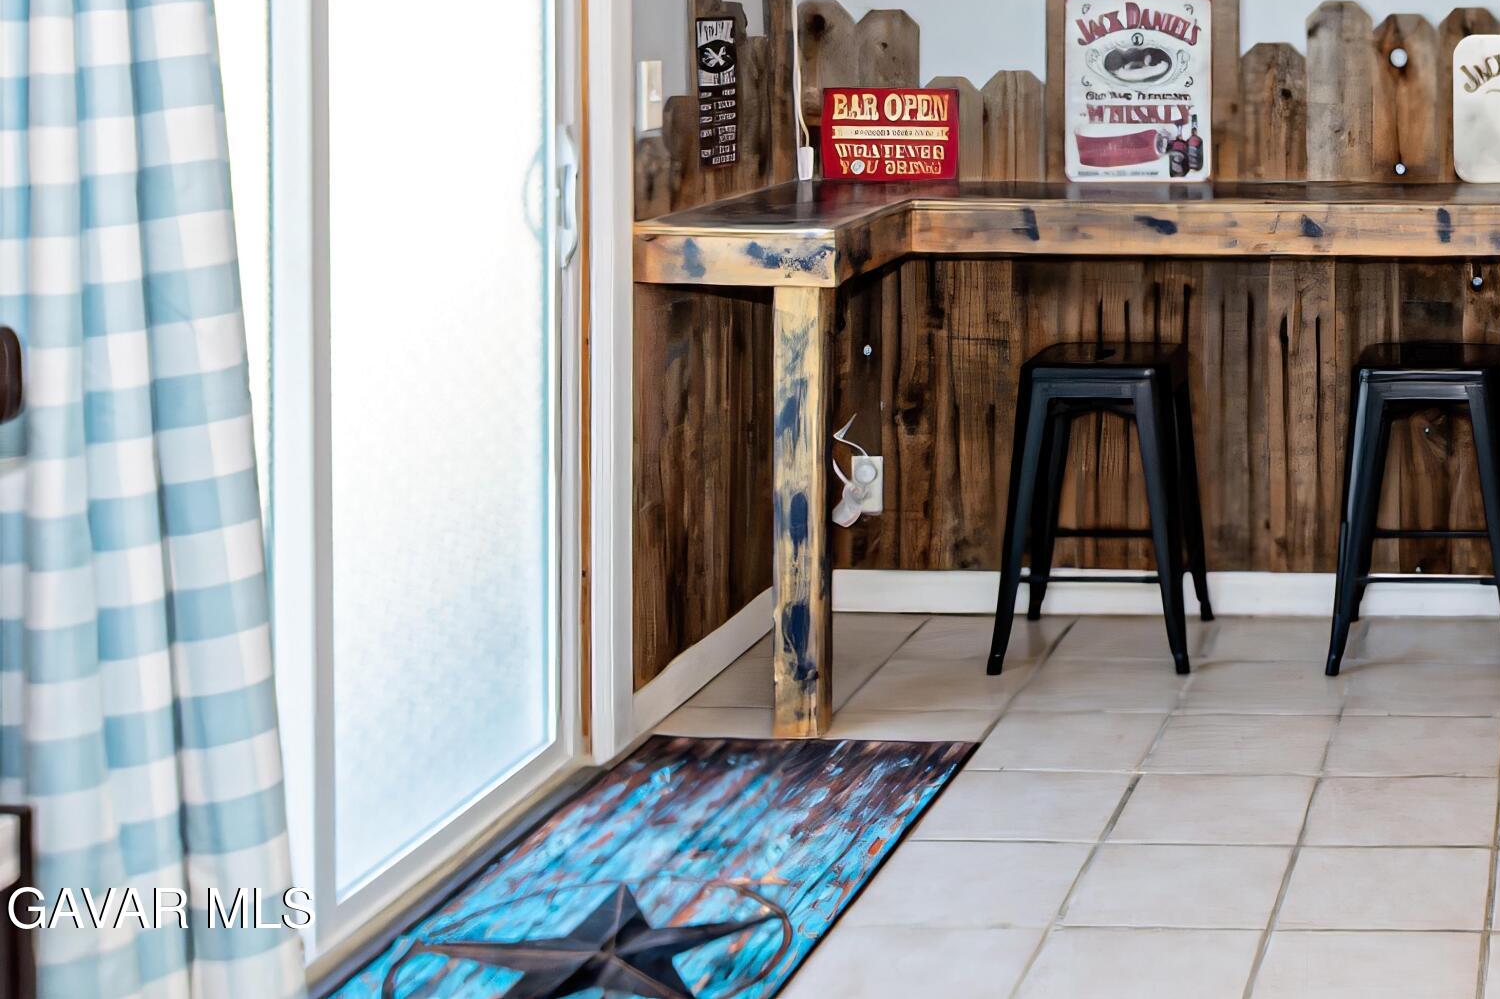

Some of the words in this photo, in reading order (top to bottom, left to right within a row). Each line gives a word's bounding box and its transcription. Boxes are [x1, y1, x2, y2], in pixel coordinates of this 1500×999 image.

[832, 93, 880, 121] BAR
[883, 93, 949, 122] OPEN
[840, 160, 879, 175] YOU
